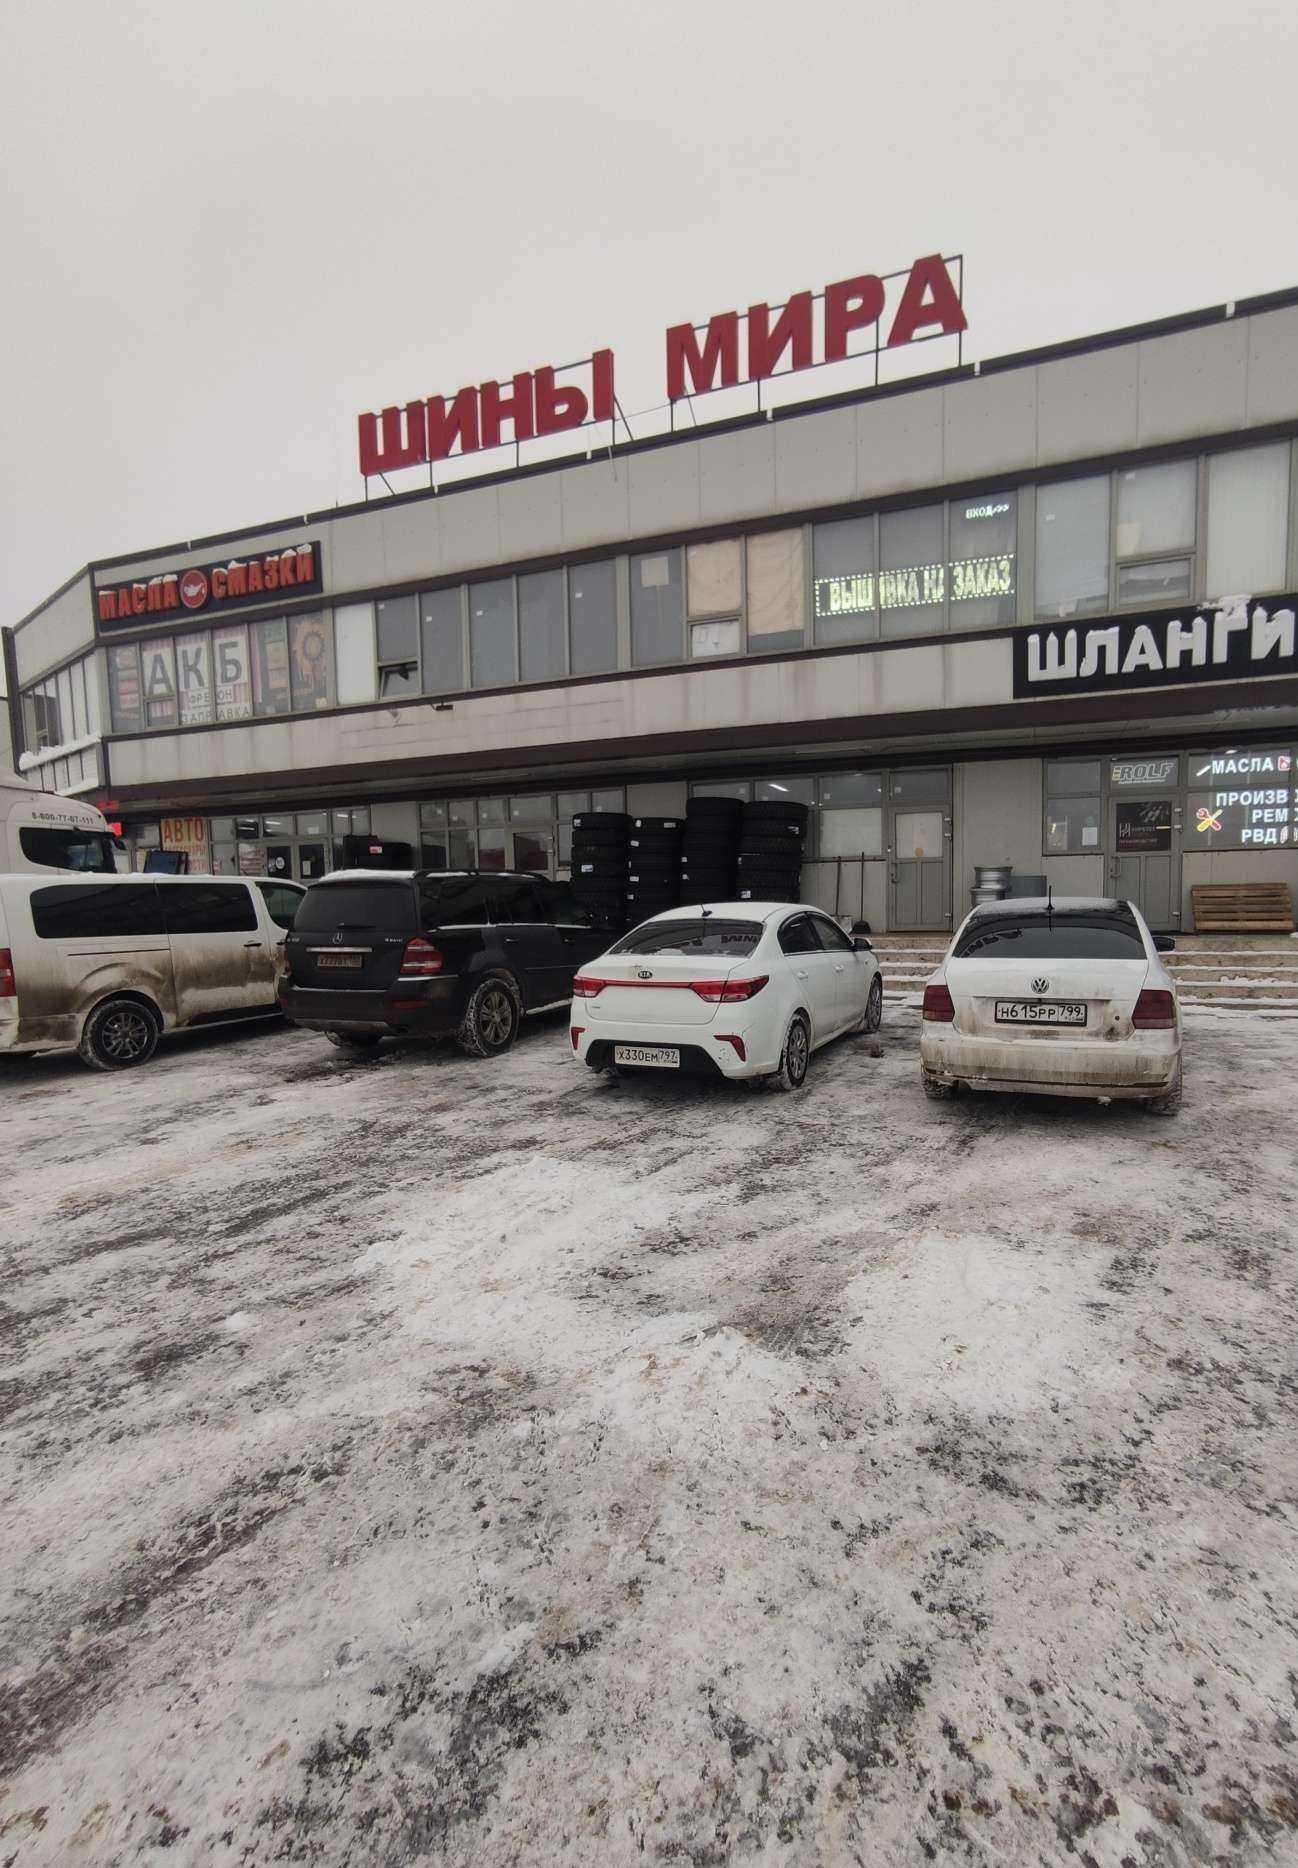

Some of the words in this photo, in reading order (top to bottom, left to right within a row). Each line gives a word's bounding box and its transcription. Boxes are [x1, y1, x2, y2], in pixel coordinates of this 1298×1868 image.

[358, 347, 615, 476] ШИНЫ
[666, 252, 968, 401] МИРА
[98, 575, 179, 620] МАСЛА
[211, 545, 314, 599] СМАЗКИ
[953, 560, 1011, 598] ЗАКАЗ
[1027, 603, 1296, 682] ШЛАНГИ
[148, 641, 243, 696] АКБ
[1119, 762, 1175, 781] ROLF
[1211, 757, 1275, 775] МАСЛА
[1216, 789, 1289, 807] ПРОИЗВ
[1252, 808, 1289, 823] РЕМ
[163, 816, 205, 842] АВТО
[1241, 828, 1278, 845] РВД
